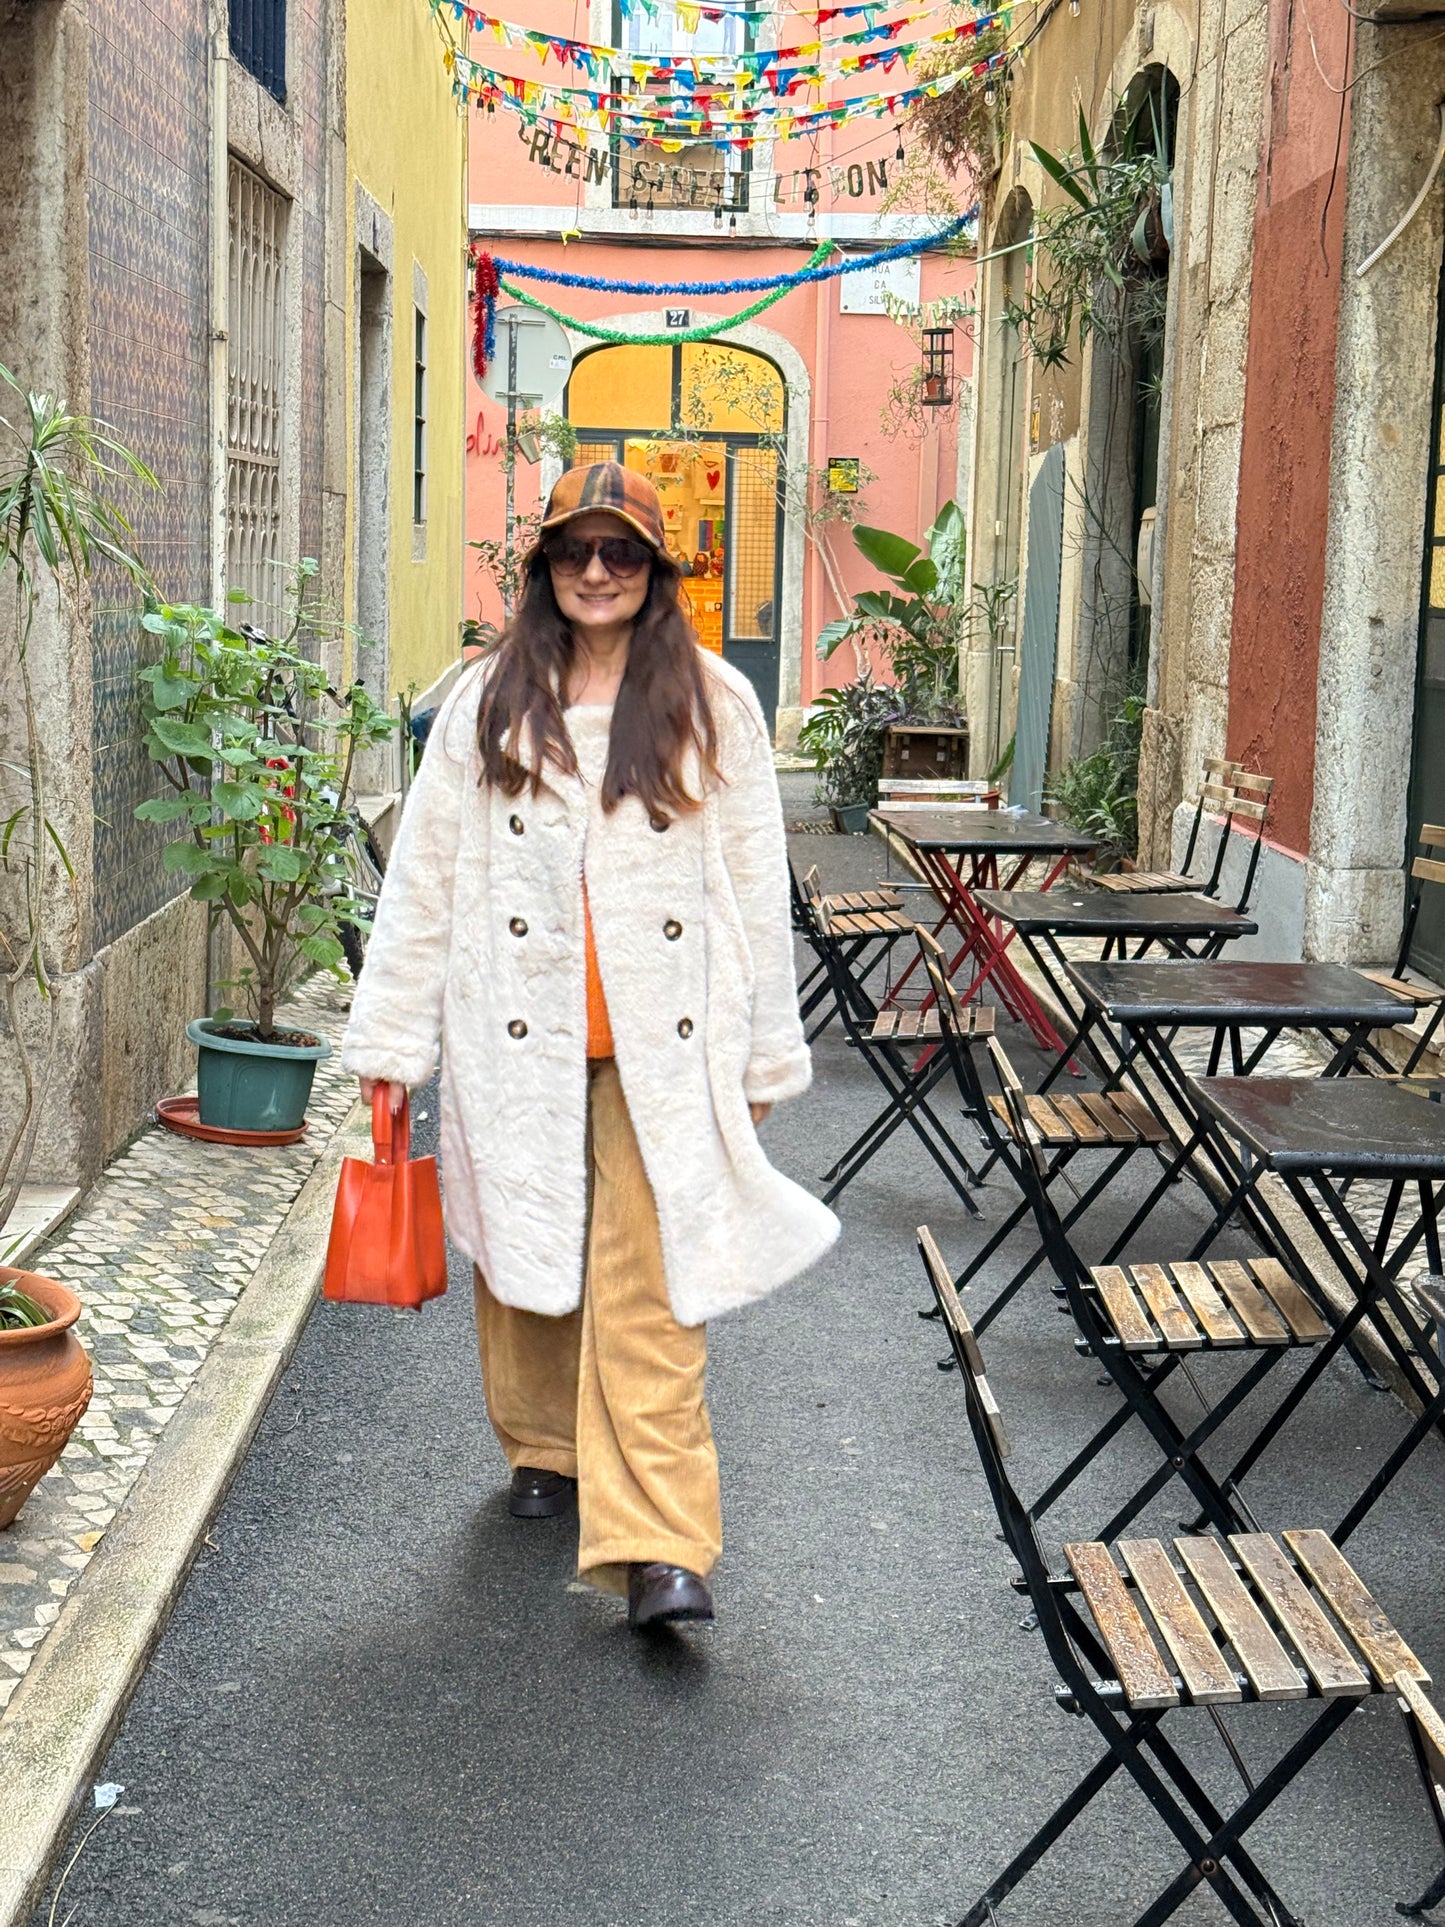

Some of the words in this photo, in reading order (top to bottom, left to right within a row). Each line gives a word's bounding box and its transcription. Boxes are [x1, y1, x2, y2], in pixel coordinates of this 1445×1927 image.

[773, 160, 887, 204] LISBON
[869, 295, 889, 305] SILV
[670, 310, 685, 325] 27
